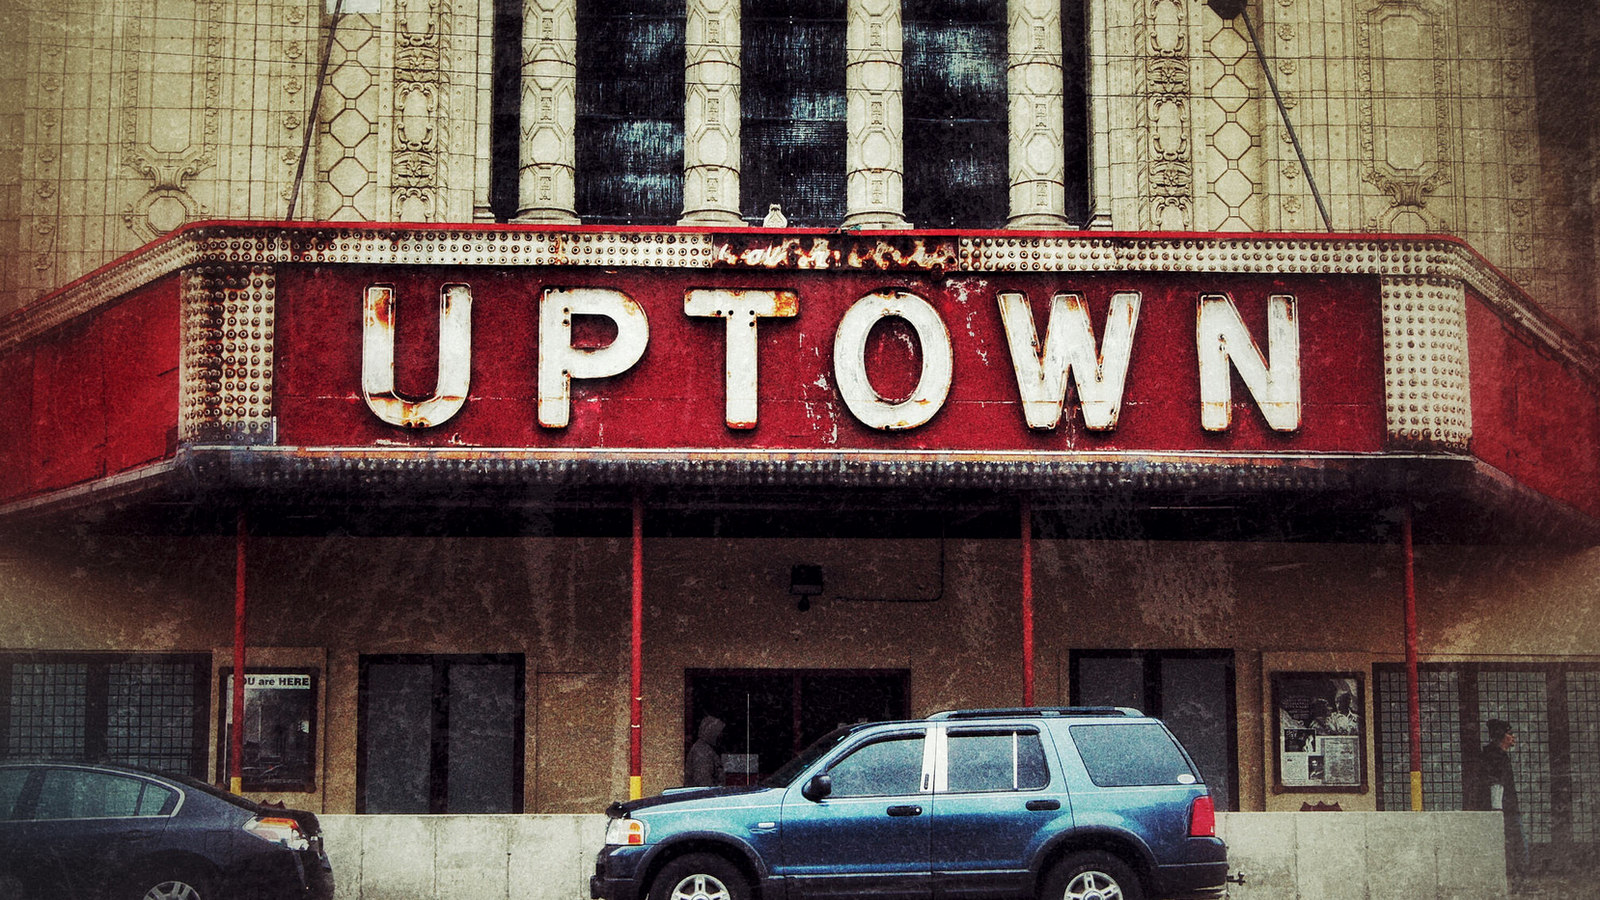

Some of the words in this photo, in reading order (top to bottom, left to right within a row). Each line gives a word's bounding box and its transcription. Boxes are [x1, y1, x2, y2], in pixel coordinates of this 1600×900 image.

[362, 282, 1301, 432] UPTOWN
[258, 678, 275, 686] are
[278, 677, 310, 686] HERE
